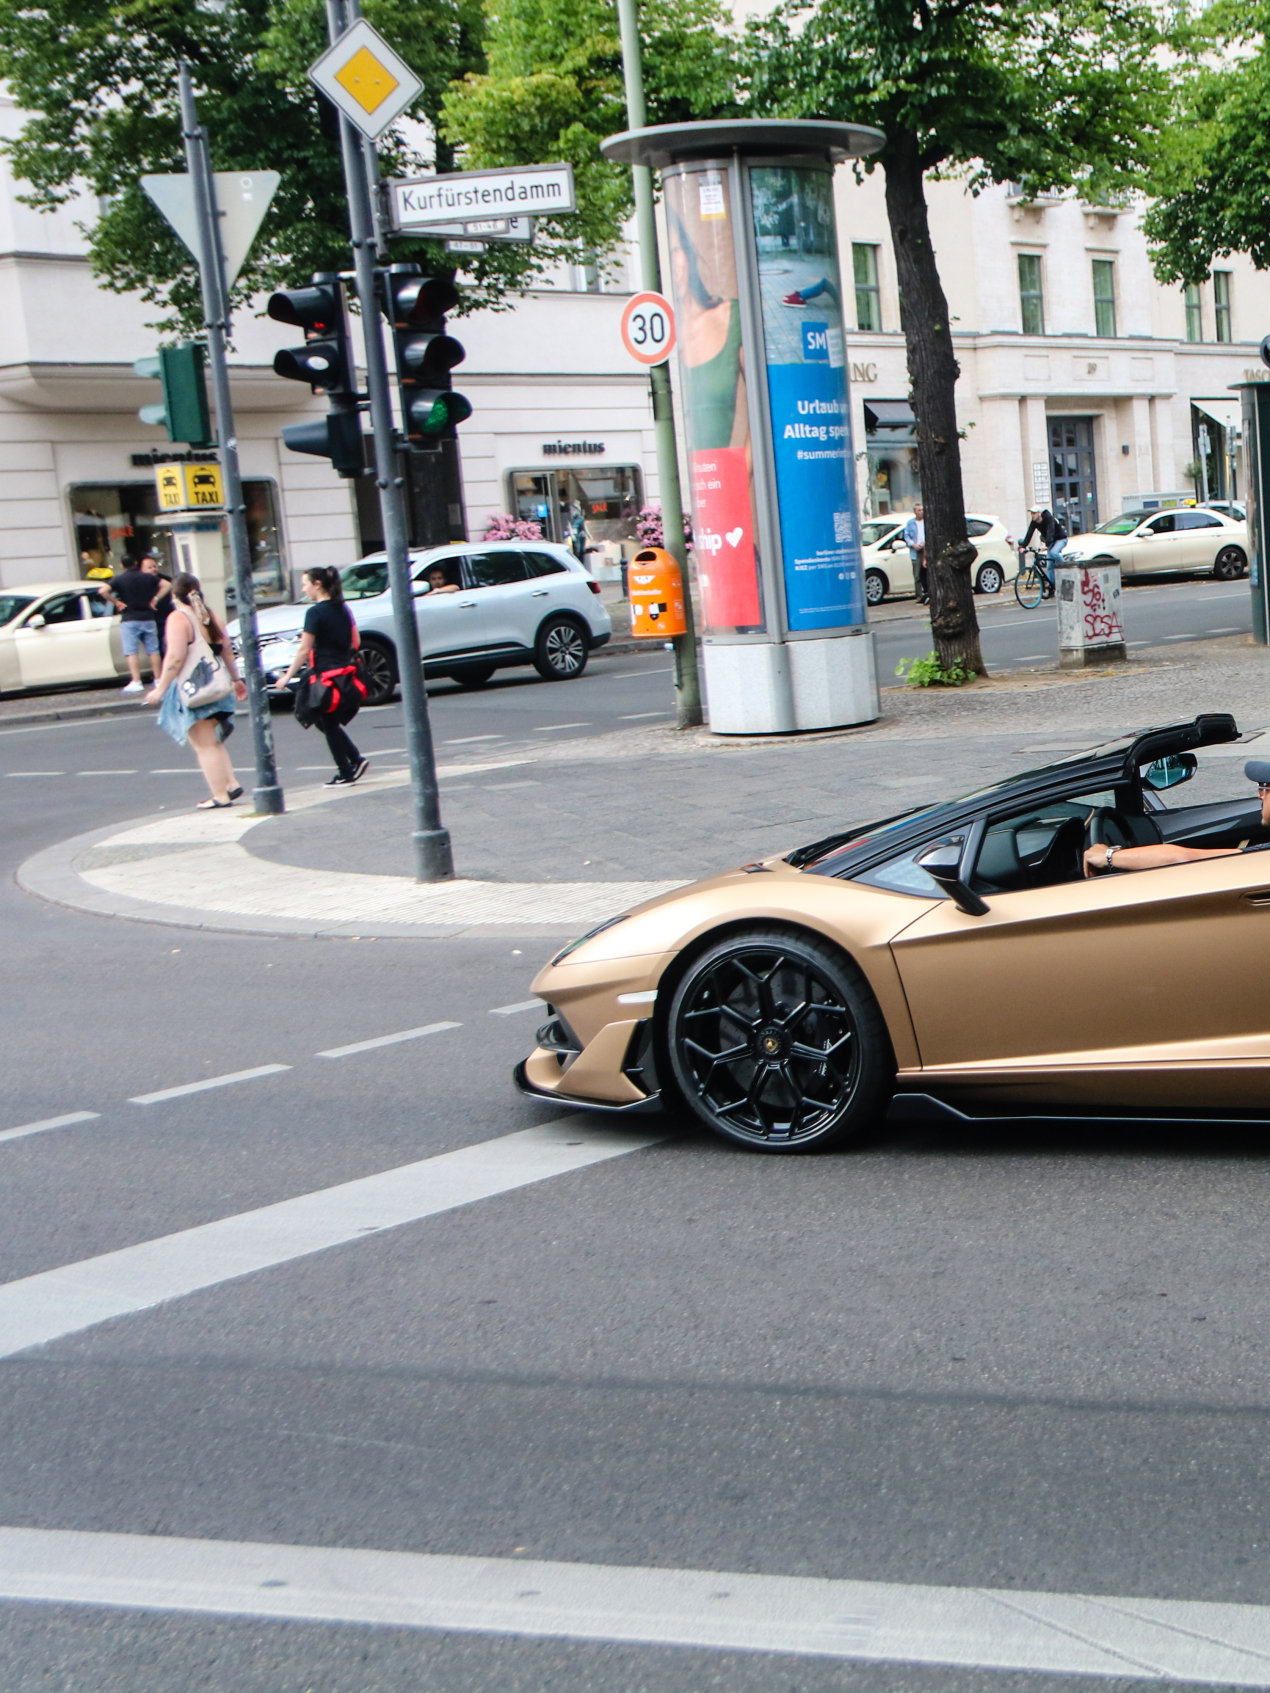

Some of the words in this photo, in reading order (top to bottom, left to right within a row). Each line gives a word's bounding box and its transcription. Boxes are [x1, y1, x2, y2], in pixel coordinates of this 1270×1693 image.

[402, 180, 562, 212] Kurfürstendamm
[632, 312, 664, 345] 30
[797, 400, 839, 414] Urlaub
[784, 423, 827, 441] Alltag
[543, 440, 605, 455] mientus
[708, 479, 721, 490] ein
[164, 493, 180, 506] TAXI
[194, 491, 219, 504] TAXI
[592, 502, 608, 514] SALE
